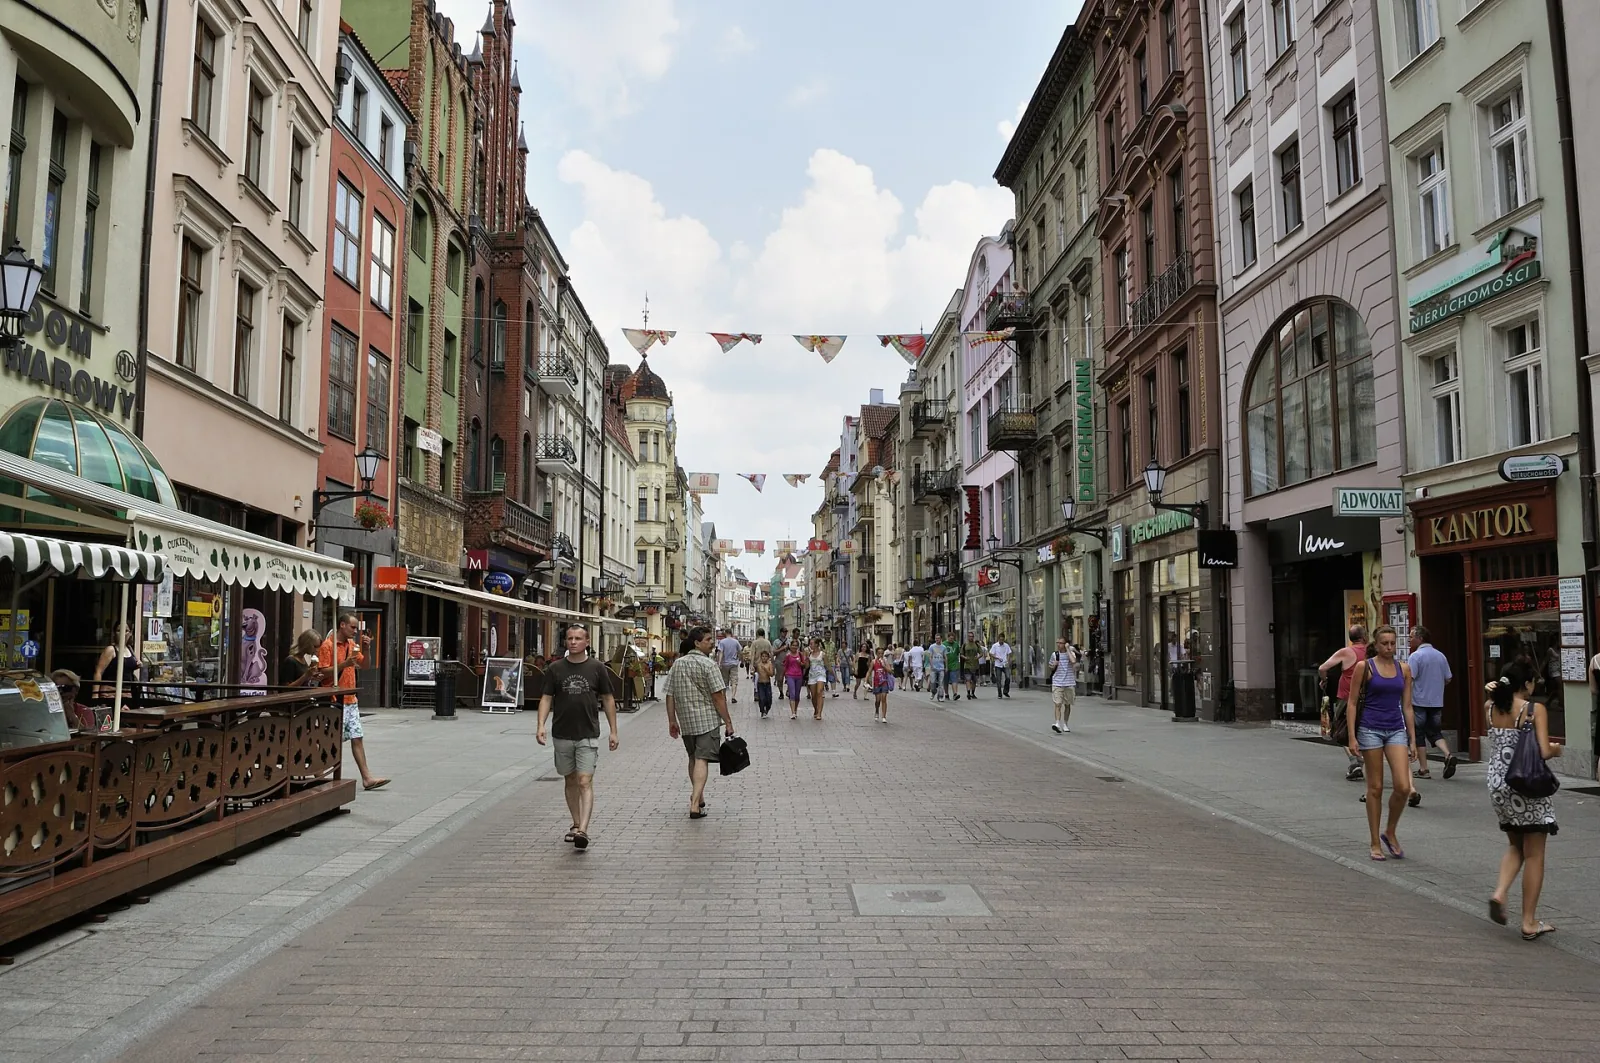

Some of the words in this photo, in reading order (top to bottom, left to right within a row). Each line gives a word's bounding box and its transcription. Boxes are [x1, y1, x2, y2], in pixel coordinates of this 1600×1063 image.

[1411, 266, 1529, 330] NIERUCHOMOŚCI
[1076, 360, 1095, 501] DEICHMANN
[1341, 492, 1401, 509] ADWOKAT
[1131, 507, 1195, 545] DEICHMANN
[1430, 503, 1532, 545] KANTOR
[167, 536, 200, 557] CUKIERNIA
